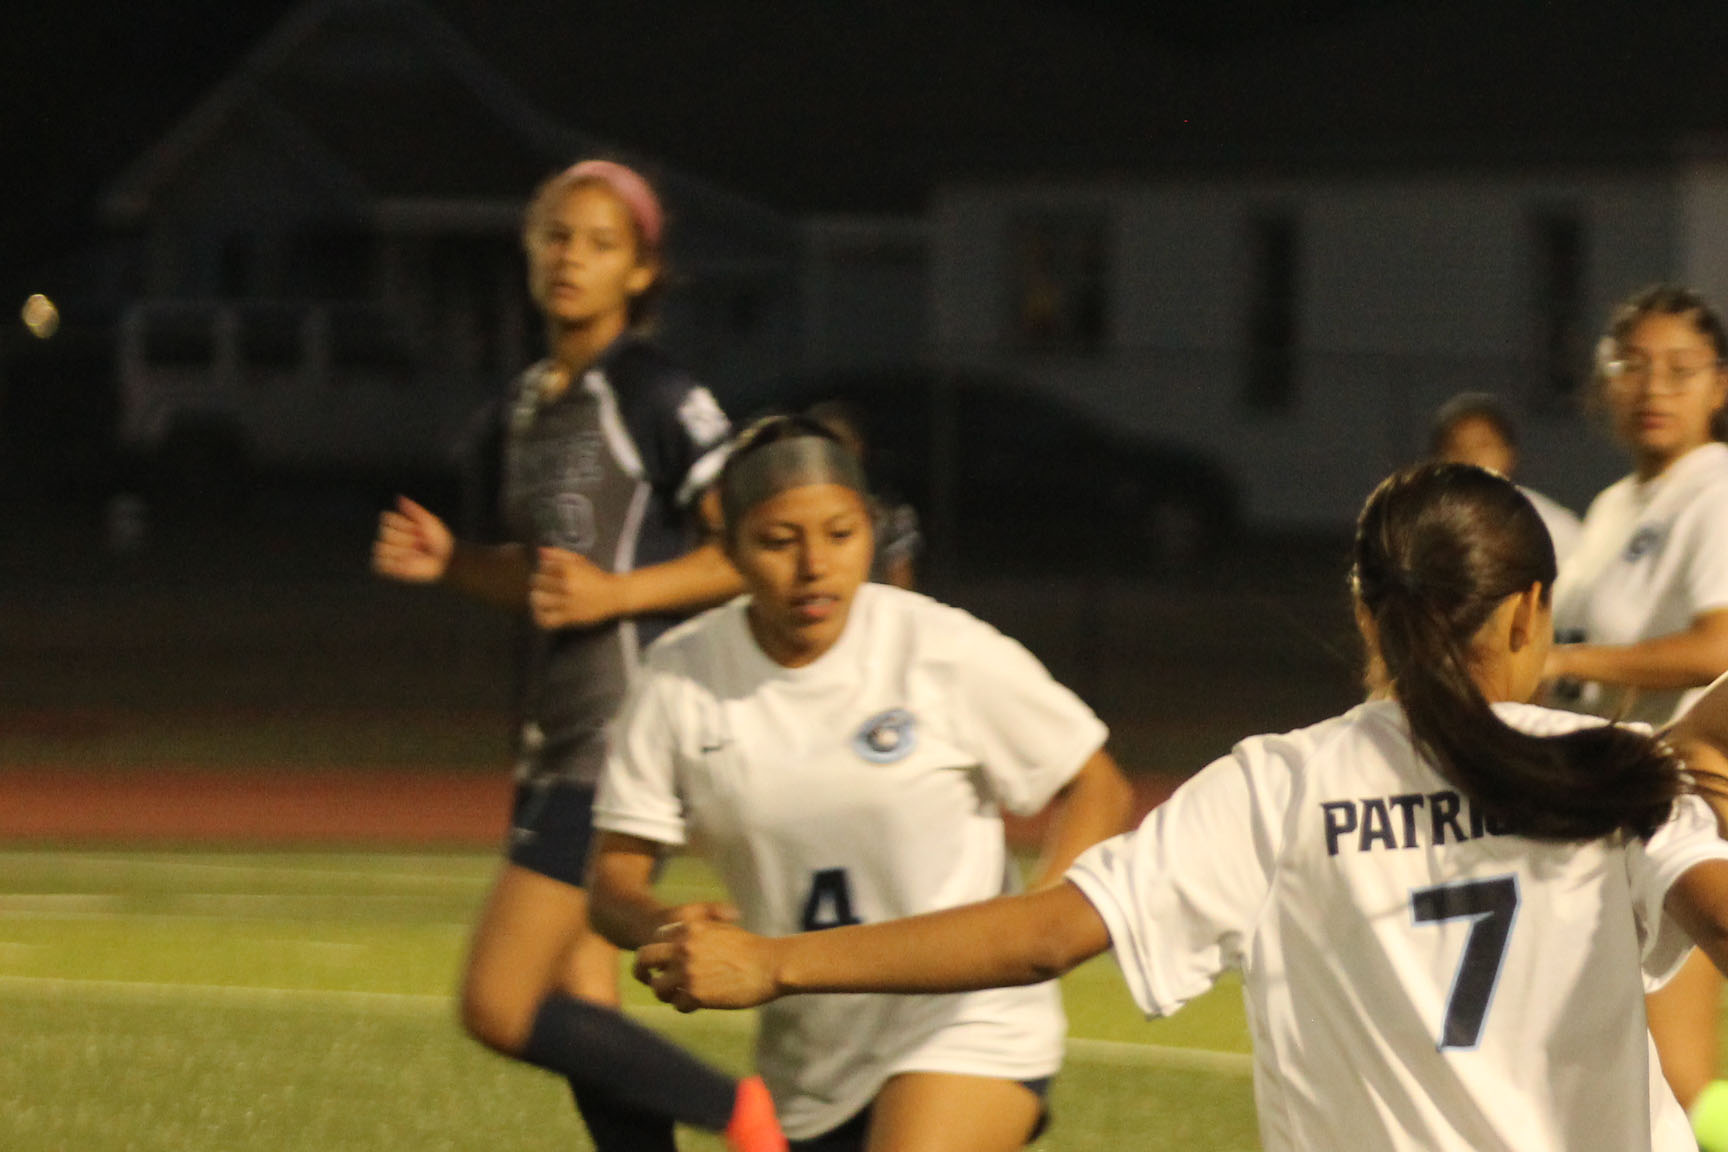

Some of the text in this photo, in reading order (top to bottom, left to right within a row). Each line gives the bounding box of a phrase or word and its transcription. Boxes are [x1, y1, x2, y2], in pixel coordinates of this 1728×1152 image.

[1320, 789, 1506, 857] PATRI
[801, 867, 862, 932] 4
[1409, 872, 1521, 1052] 7
